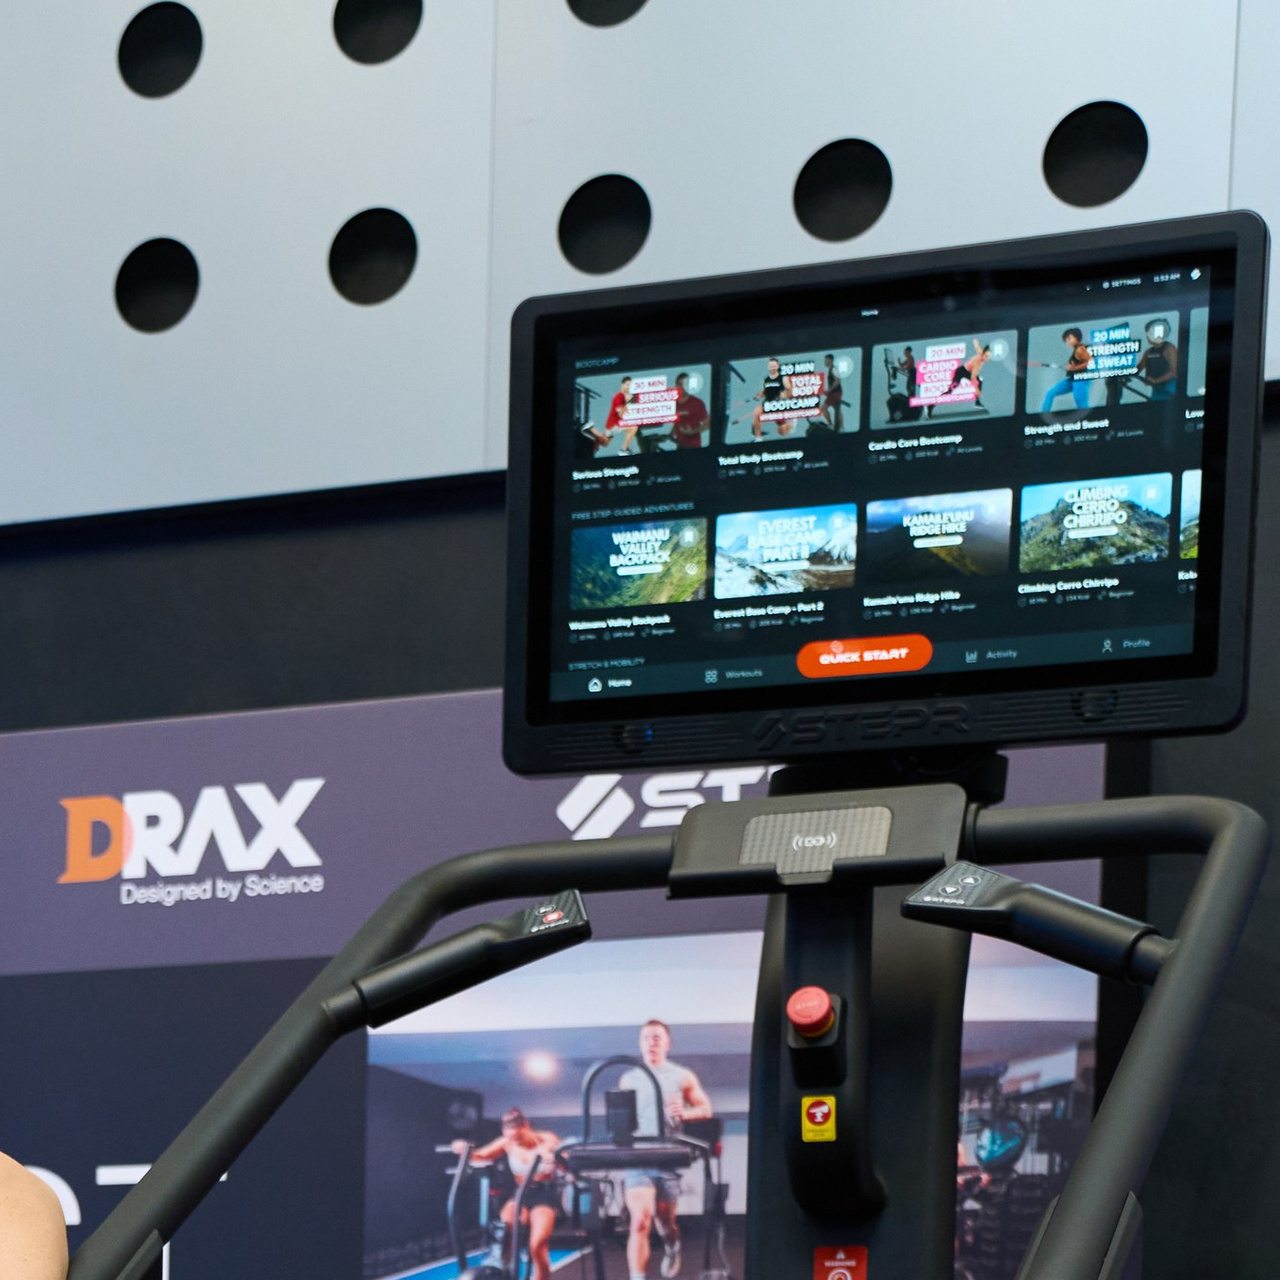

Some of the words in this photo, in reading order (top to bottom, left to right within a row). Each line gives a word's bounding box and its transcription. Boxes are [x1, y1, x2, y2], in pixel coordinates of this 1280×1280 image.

[1094, 330, 1107, 342] 20
[1109, 327, 1130, 340] MIN
[946, 346, 965, 356] MIN
[1087, 341, 1140, 357] STRENGTH
[780, 364, 794, 375] 20
[795, 362, 815, 374] MIN
[919, 361, 958, 373] CARDIO
[1098, 354, 1134, 369] SWEAT
[791, 374, 822, 387] TOTAL
[924, 371, 952, 382] CORE
[1074, 372, 1099, 381] HYBRID
[1099, 367, 1139, 379] BOOTCAMP
[792, 386, 821, 397] BODY
[625, 405, 672, 417] STRENGTH
[763, 397, 820, 412] BOOTCAMP
[1024, 423, 1063, 436] Strength
[1063, 421, 1081, 432] and
[1081, 418, 1110, 430] Sweat
[868, 440, 897, 451] Cardio
[898, 438, 919, 449] Core
[919, 434, 963, 447] Bootcamp
[718, 456, 739, 466] Total
[740, 454, 761, 465] Body
[761, 450, 804, 462] Bootcamp
[572, 470, 603, 481] Serious
[603, 465, 639, 478] Strength
[1064, 484, 1130, 502] CLIMBING
[1072, 499, 1120, 515] CERRO
[760, 515, 817, 535] EVEREST
[1063, 510, 1128, 529] CHIRRIPO
[612, 527, 671, 546] WAIMANU
[910, 523, 941, 537] RIDGE
[941, 521, 968, 534] HIKE
[620, 541, 662, 555] VALLEY
[762, 546, 799, 563] PART
[609, 551, 671, 568] BACKPACK
[1018, 581, 1056, 594] Climbing
[1057, 580, 1083, 592] Cerro
[1083, 577, 1120, 590] Chirripo
[915, 592, 940, 604] Ridge
[940, 590, 961, 601] Hike
[713, 608, 746, 620] Everest
[745, 606, 767, 617] Base
[767, 604, 792, 616] Camp
[797, 602, 817, 613] Part
[817, 601, 825, 612] 2
[607, 618, 632, 628] Valley
[632, 614, 671, 627] Backpack
[1122, 638, 1151, 649] Profile
[819, 650, 861, 665] QUICK
[862, 647, 909, 662] START
[986, 648, 1018, 660] Activity
[568, 660, 602, 672] STRETCH
[609, 657, 646, 668] MOBILITY
[724, 669, 764, 680] Workouts
[607, 679, 632, 688] Home
[789, 701, 972, 746] STEPR
[56, 777, 326, 884] DRAX
[120, 877, 213, 907] Designed
[215, 878, 244, 902] by
[244, 872, 325, 897] Science
